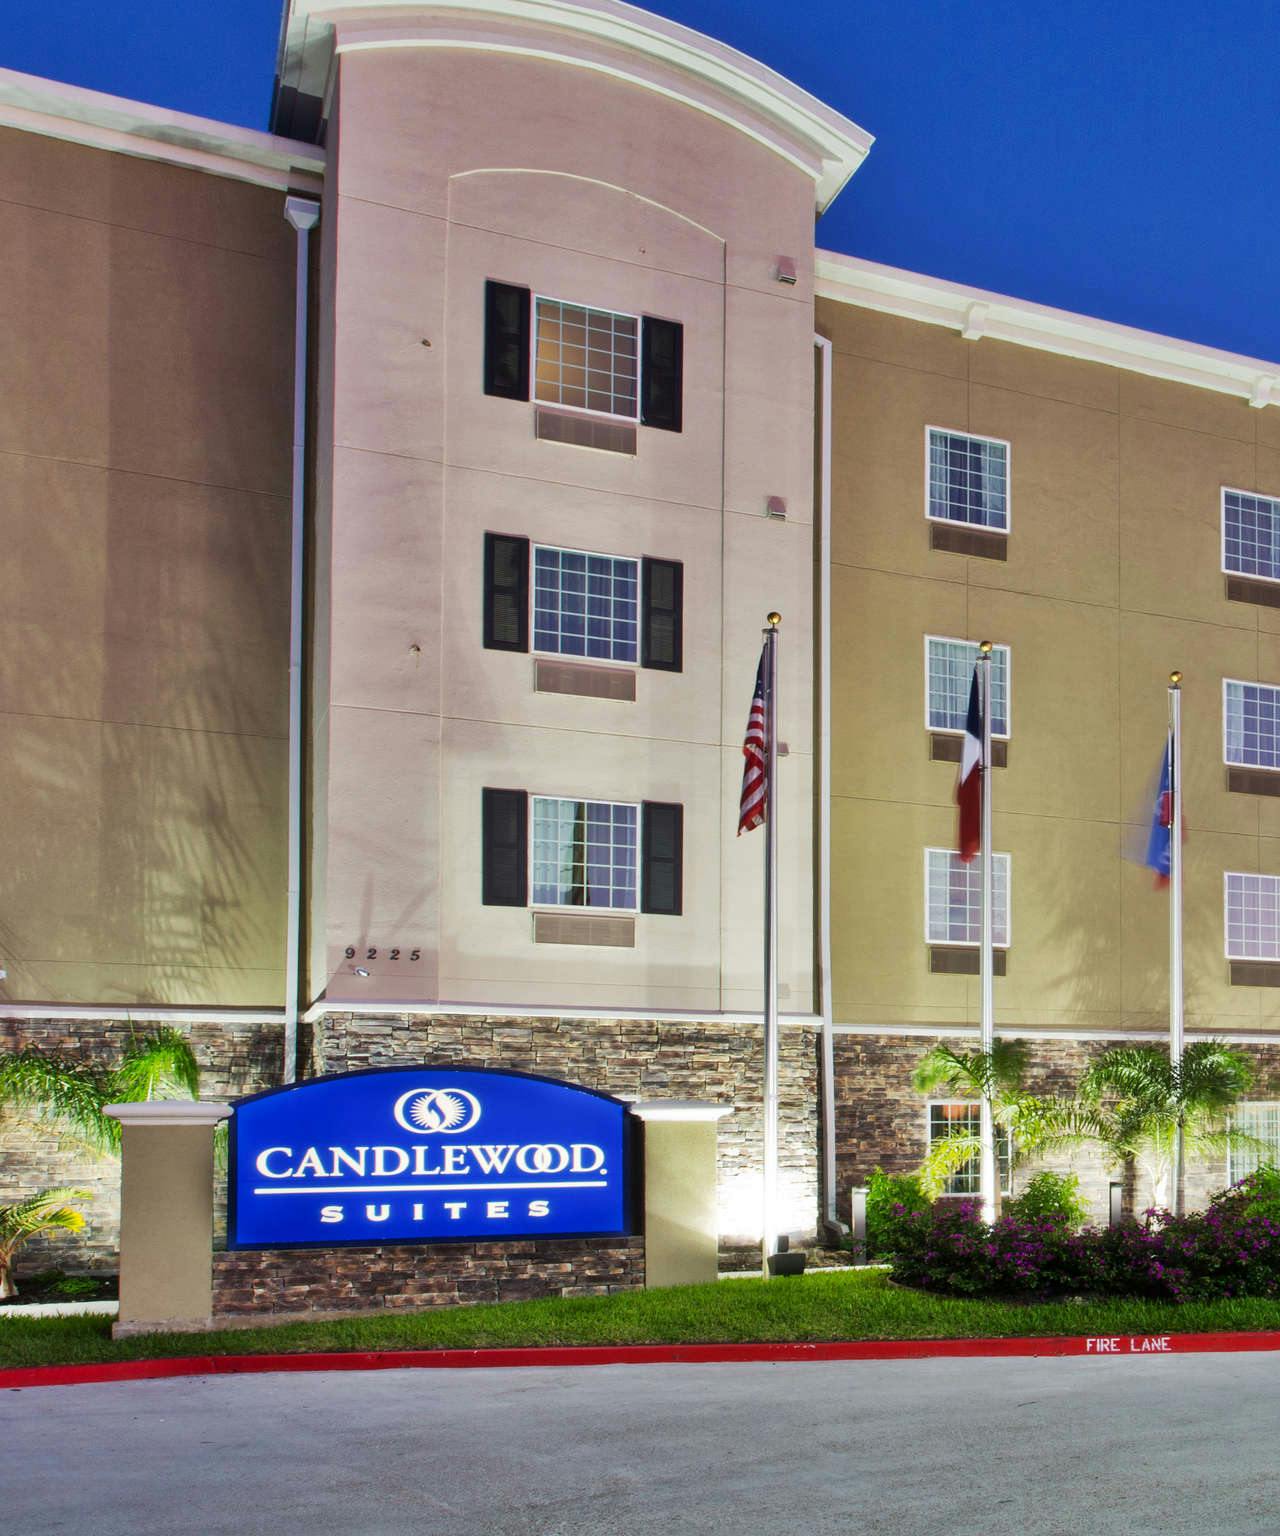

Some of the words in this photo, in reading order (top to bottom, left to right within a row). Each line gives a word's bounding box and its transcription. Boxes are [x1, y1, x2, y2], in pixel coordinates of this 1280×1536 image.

[345, 947, 420, 961] 9225
[320, 1200, 550, 1223] SUITES
[1086, 1338, 1121, 1352] FIRE
[1130, 1337, 1171, 1352] LANE
